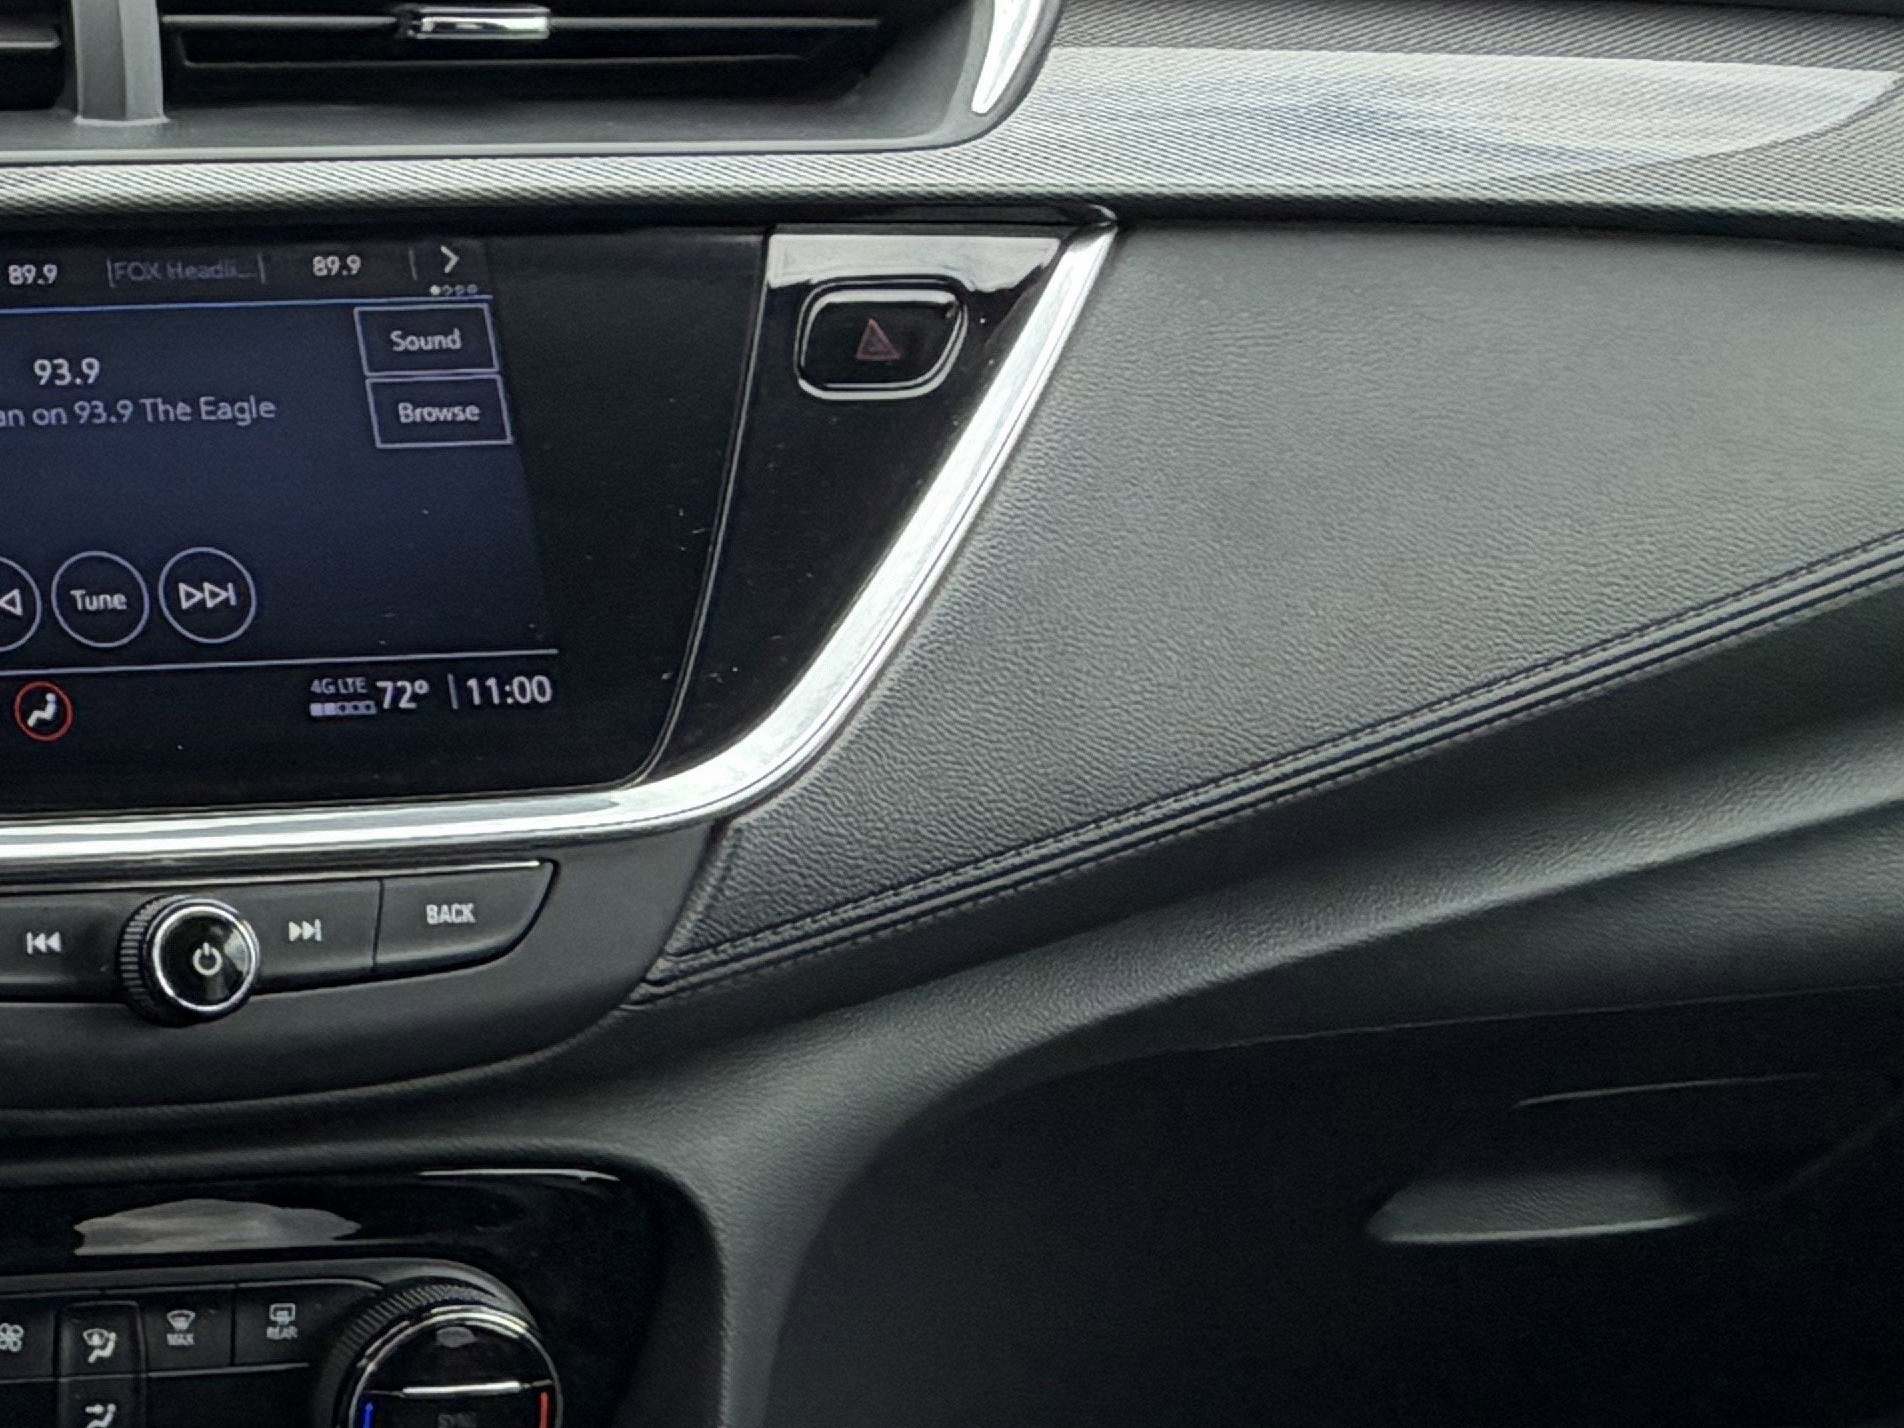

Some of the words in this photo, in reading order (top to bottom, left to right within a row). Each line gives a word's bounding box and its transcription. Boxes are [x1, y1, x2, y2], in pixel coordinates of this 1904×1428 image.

[7, 264, 59, 286] 89.9
[311, 254, 363, 277] 89.9
[390, 328, 463, 351] Sound
[32, 356, 102, 387] 93.9
[31, 406, 69, 427] on
[72, 399, 134, 424] 93.9
[139, 396, 193, 423] The
[198, 394, 278, 428] Eagle
[397, 401, 481, 424] Browse
[70, 589, 128, 612] Tune
[309, 677, 336, 695] 4G
[337, 675, 369, 694] LTE
[465, 674, 554, 706] 11:00
[425, 901, 476, 926] BACK
